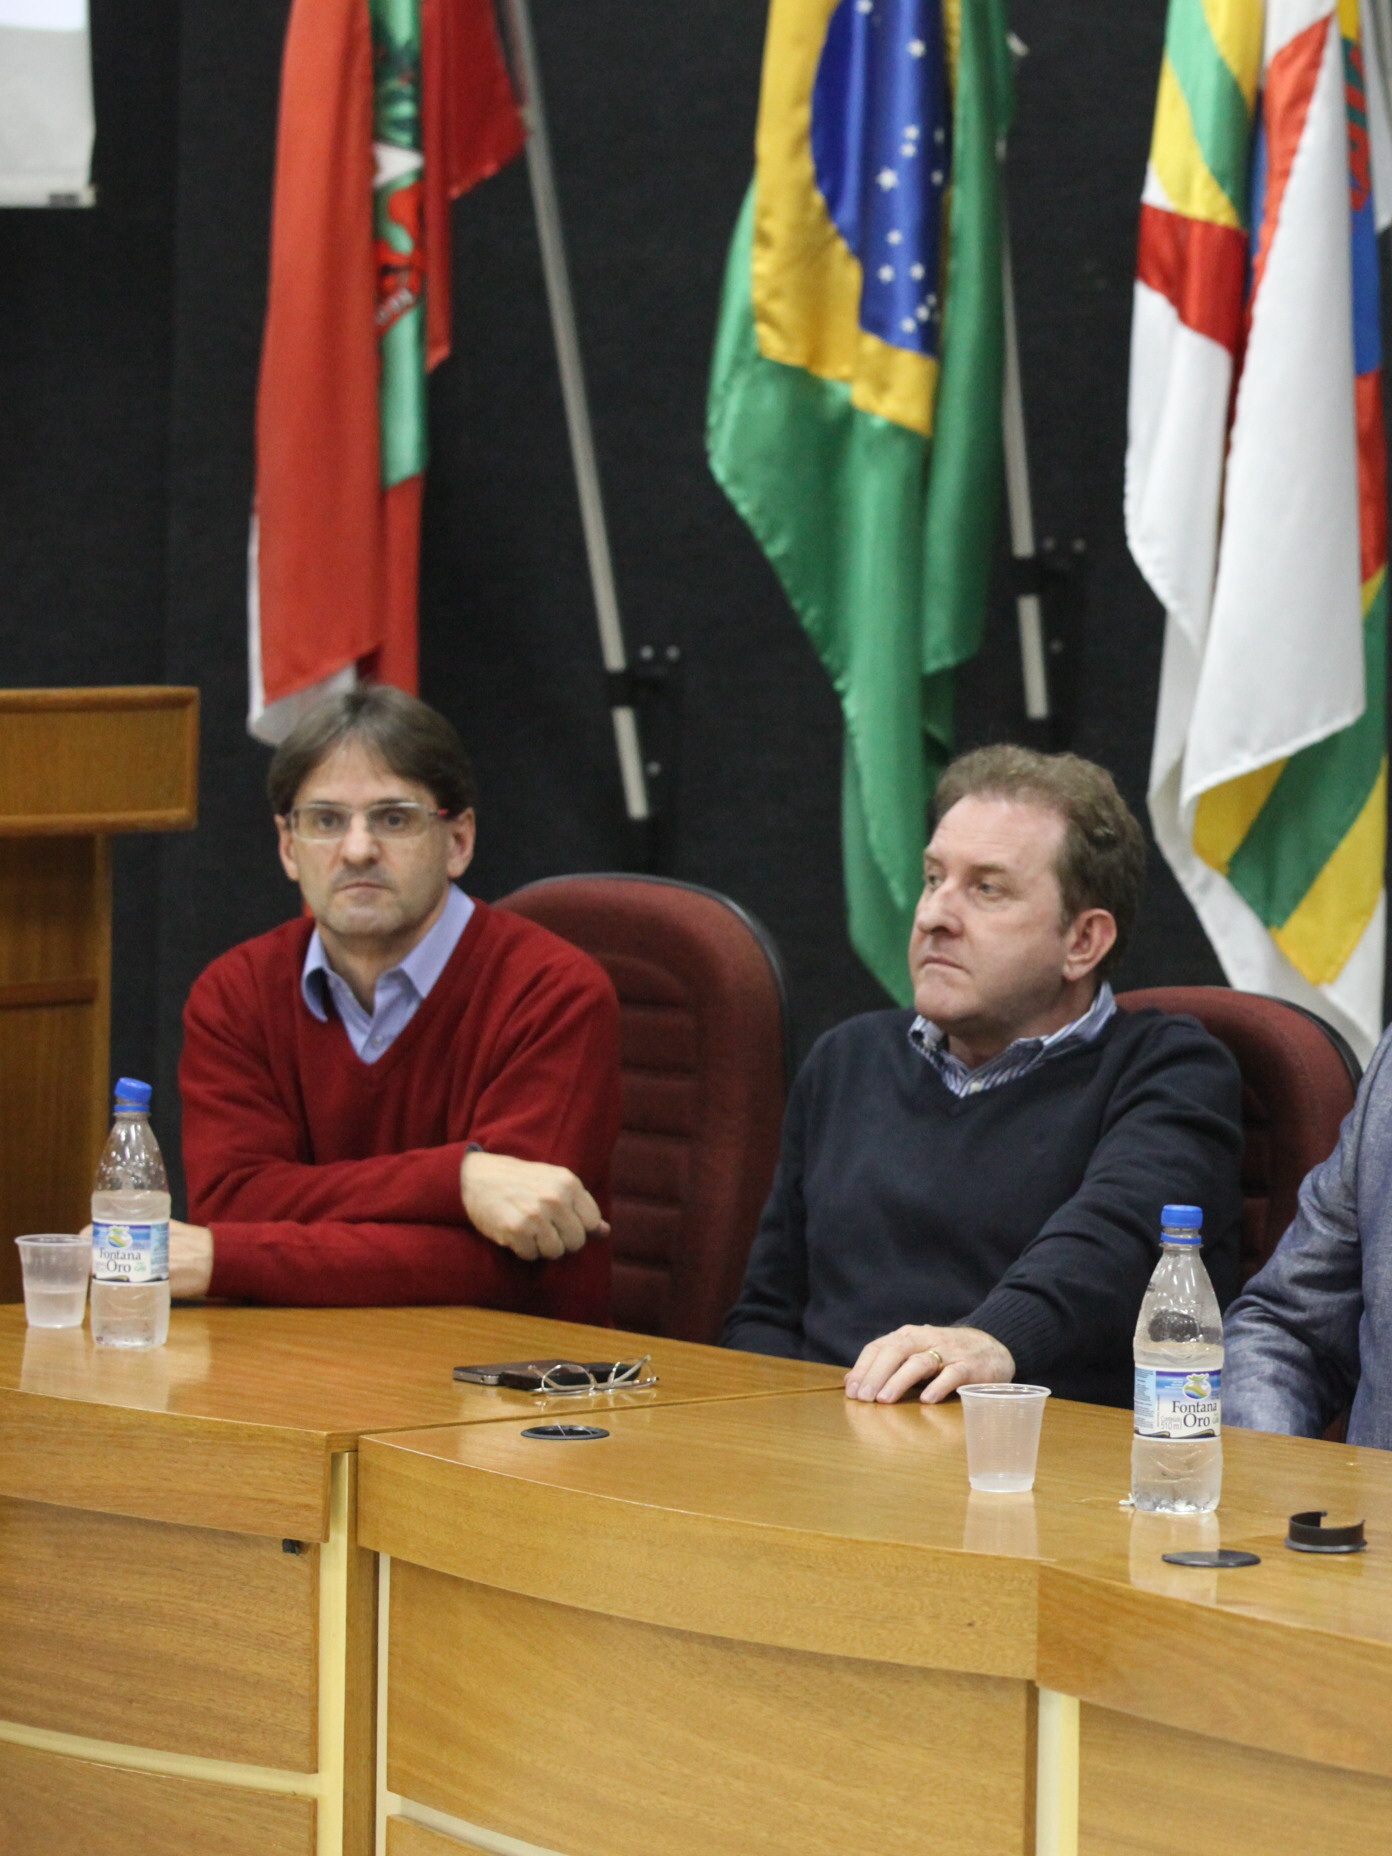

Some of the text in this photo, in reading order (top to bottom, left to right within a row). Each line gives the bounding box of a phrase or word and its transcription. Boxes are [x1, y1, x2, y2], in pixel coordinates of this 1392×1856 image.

[99, 1248, 141, 1260] Fontana
[106, 1259, 131, 1273] Oro
[1172, 1400, 1217, 1414] Fontana
[1183, 1413, 1210, 1428] Oro
